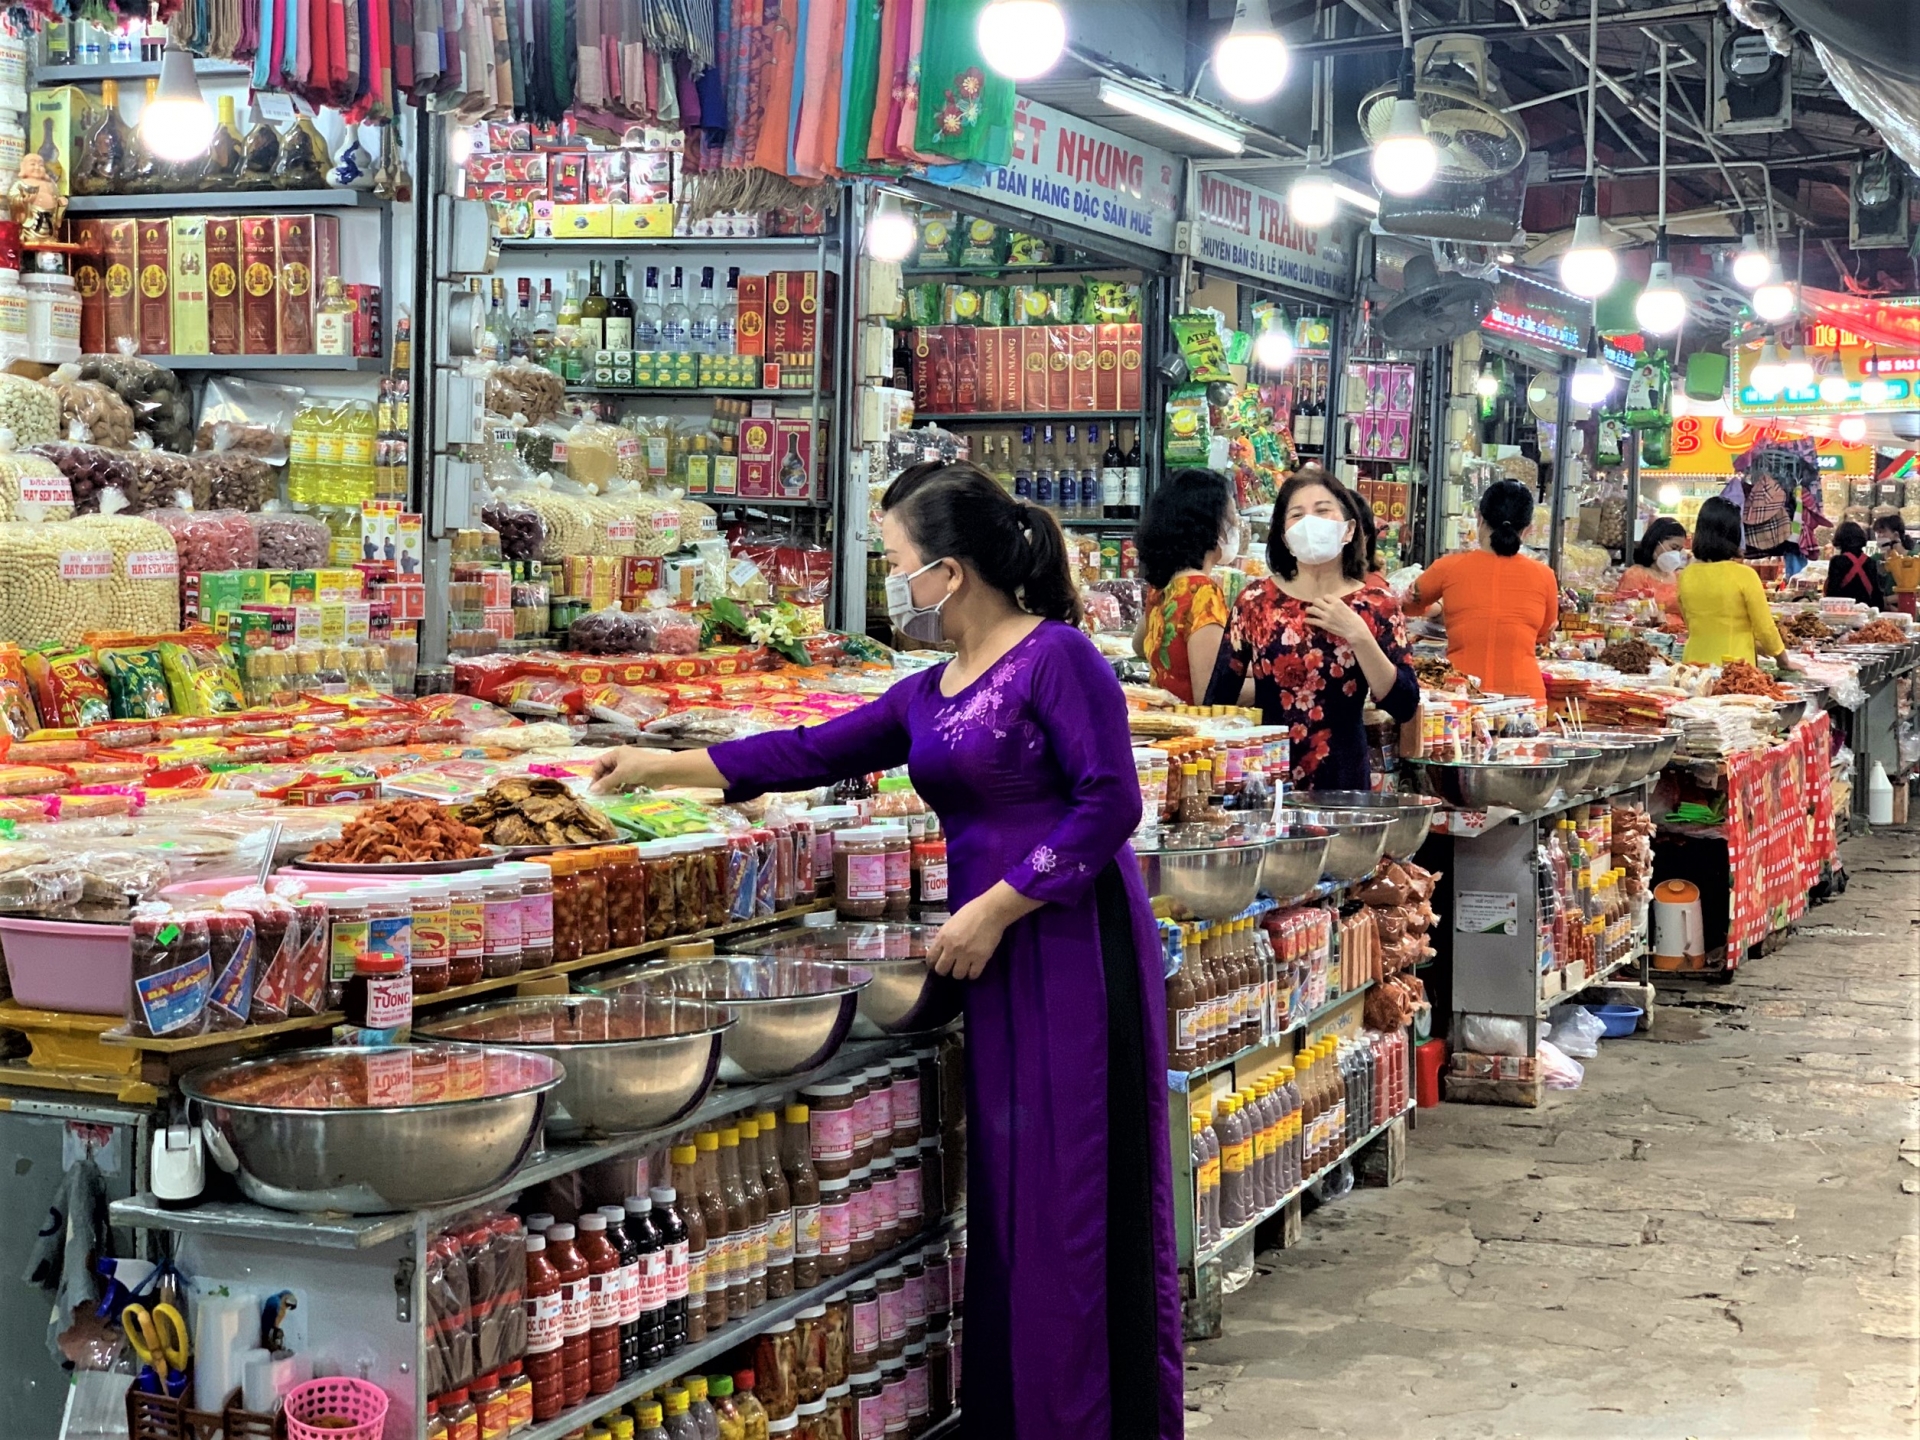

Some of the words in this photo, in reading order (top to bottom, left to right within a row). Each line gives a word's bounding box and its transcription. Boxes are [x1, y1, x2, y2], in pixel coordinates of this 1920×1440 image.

[1057, 127, 1144, 200] NHUNG
[997, 166, 1027, 197] BÁN
[1032, 174, 1070, 209] HÀNG
[1074, 188, 1099, 222] ĐẶC
[1102, 194, 1127, 227] SẢN
[1130, 208, 1153, 236] HUẾ
[1200, 175, 1252, 235] MINH
[1258, 195, 1318, 256] TRANG
[1232, 243, 1249, 267] BÁN
[1259, 257, 1265, 271] &
[1278, 256, 1298, 281] HÀNG
[39, 490, 52, 502] SEN
[81, 564, 94, 575] SEN
